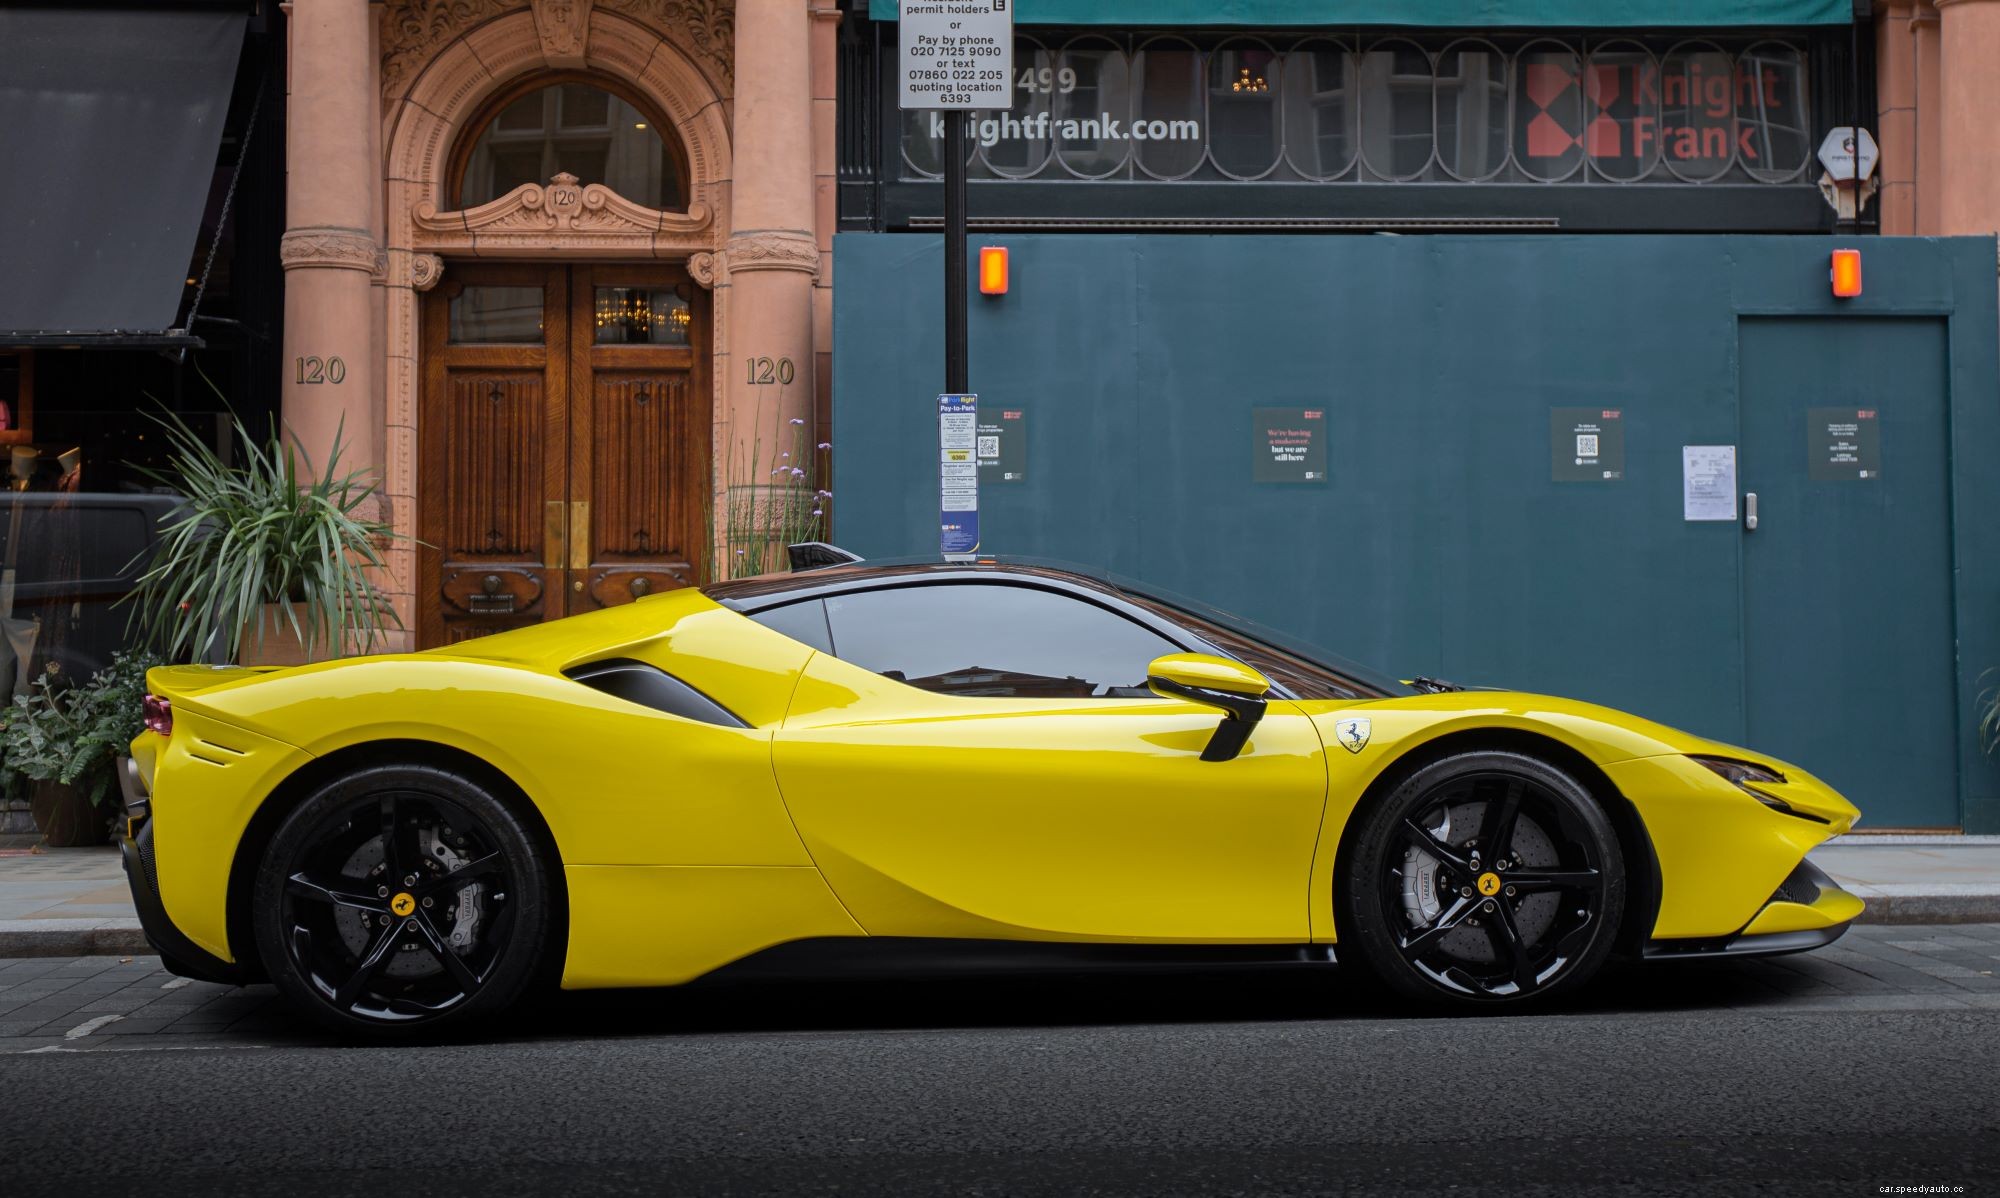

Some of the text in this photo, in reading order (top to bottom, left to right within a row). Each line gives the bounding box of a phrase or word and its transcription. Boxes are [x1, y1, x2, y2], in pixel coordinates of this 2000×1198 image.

[906, 5, 990, 15] permit holders
[950, 21, 962, 30] or
[918, 35, 994, 46] Pay by phone
[910, 47, 1002, 56] 020 7125 9090
[936, 59, 976, 68] or text
[909, 70, 1003, 80] 07860 022 205
[1013, 67, 1077, 93] 499
[909, 82, 1002, 92] quoting location
[1632, 63, 1782, 118] Knight
[940, 94, 971, 103] 6393
[930, 111, 1199, 147] kightfrank.com
[1633, 116, 1758, 159] Frank
[554, 190, 575, 206] 120
[295, 355, 346, 385] 120
[746, 356, 795, 385] 120
[1271, 445, 1284, 453] but
[1275, 453, 1305, 461] still here
